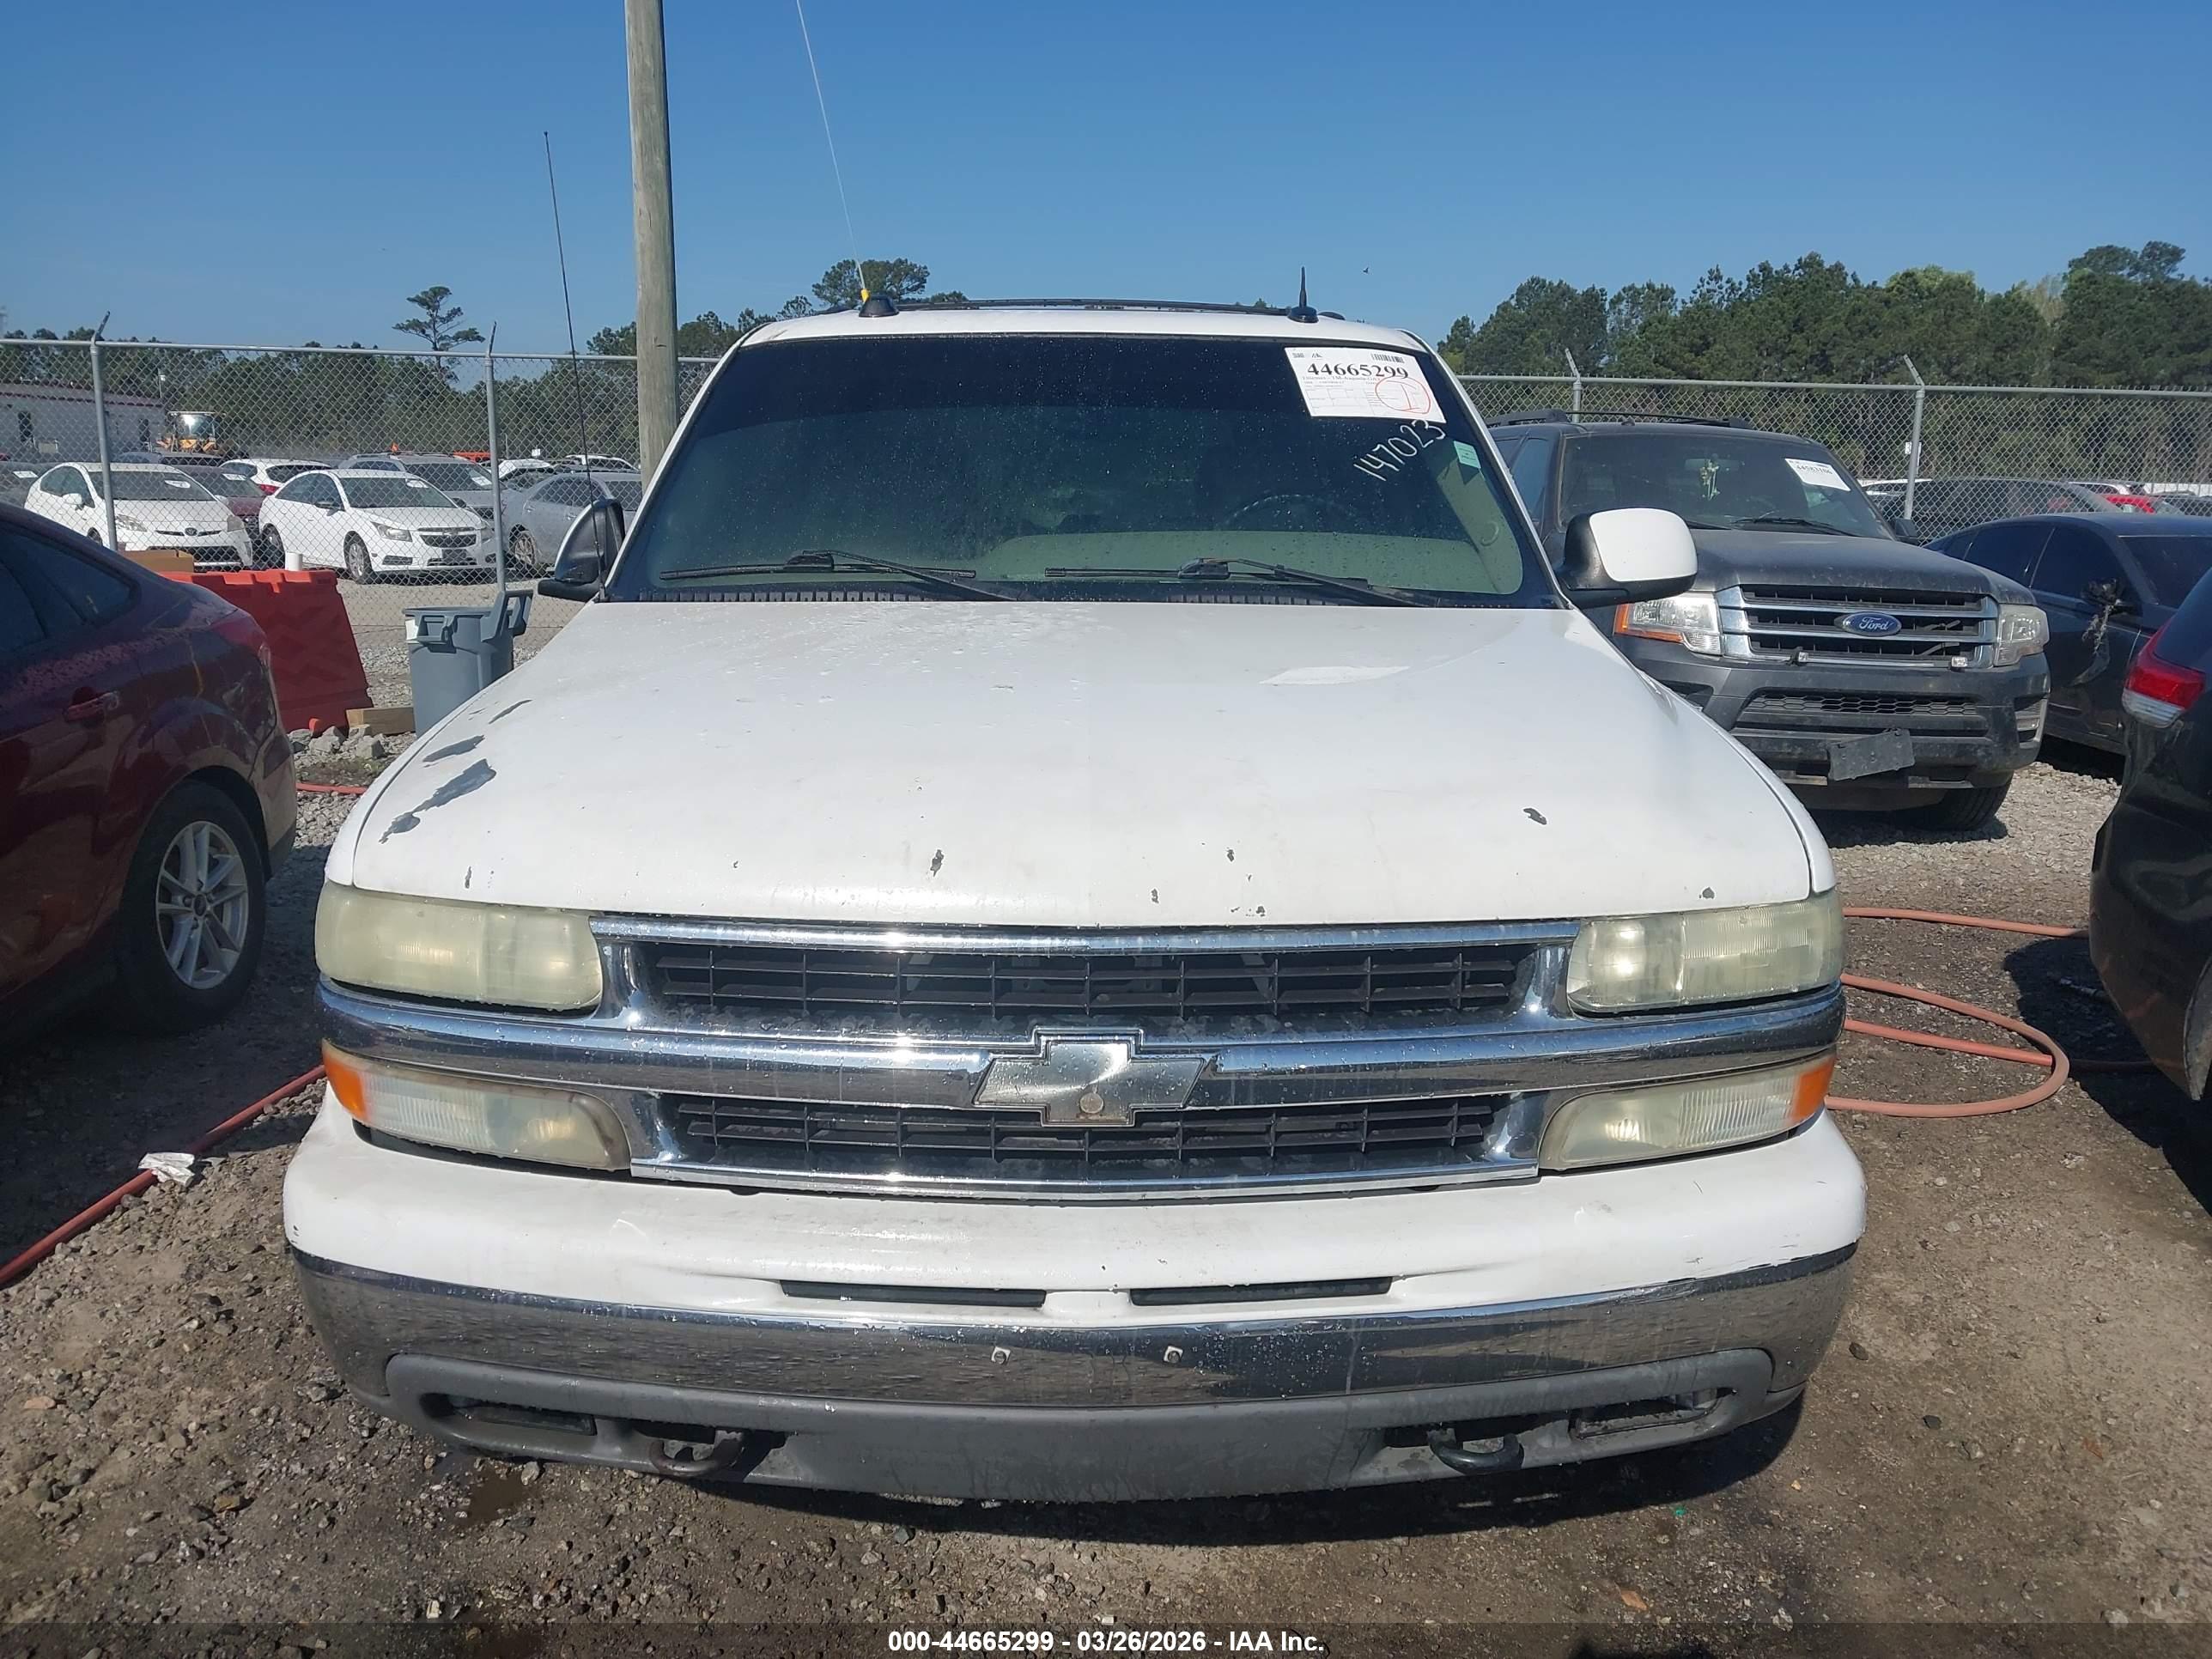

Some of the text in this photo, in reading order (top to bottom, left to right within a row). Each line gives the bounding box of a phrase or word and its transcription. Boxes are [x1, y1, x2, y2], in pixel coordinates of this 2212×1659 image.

[1307, 362, 1409, 380] 44665299
[1353, 419, 1446, 481] 147023
[1858, 616, 1892, 630] Ford
